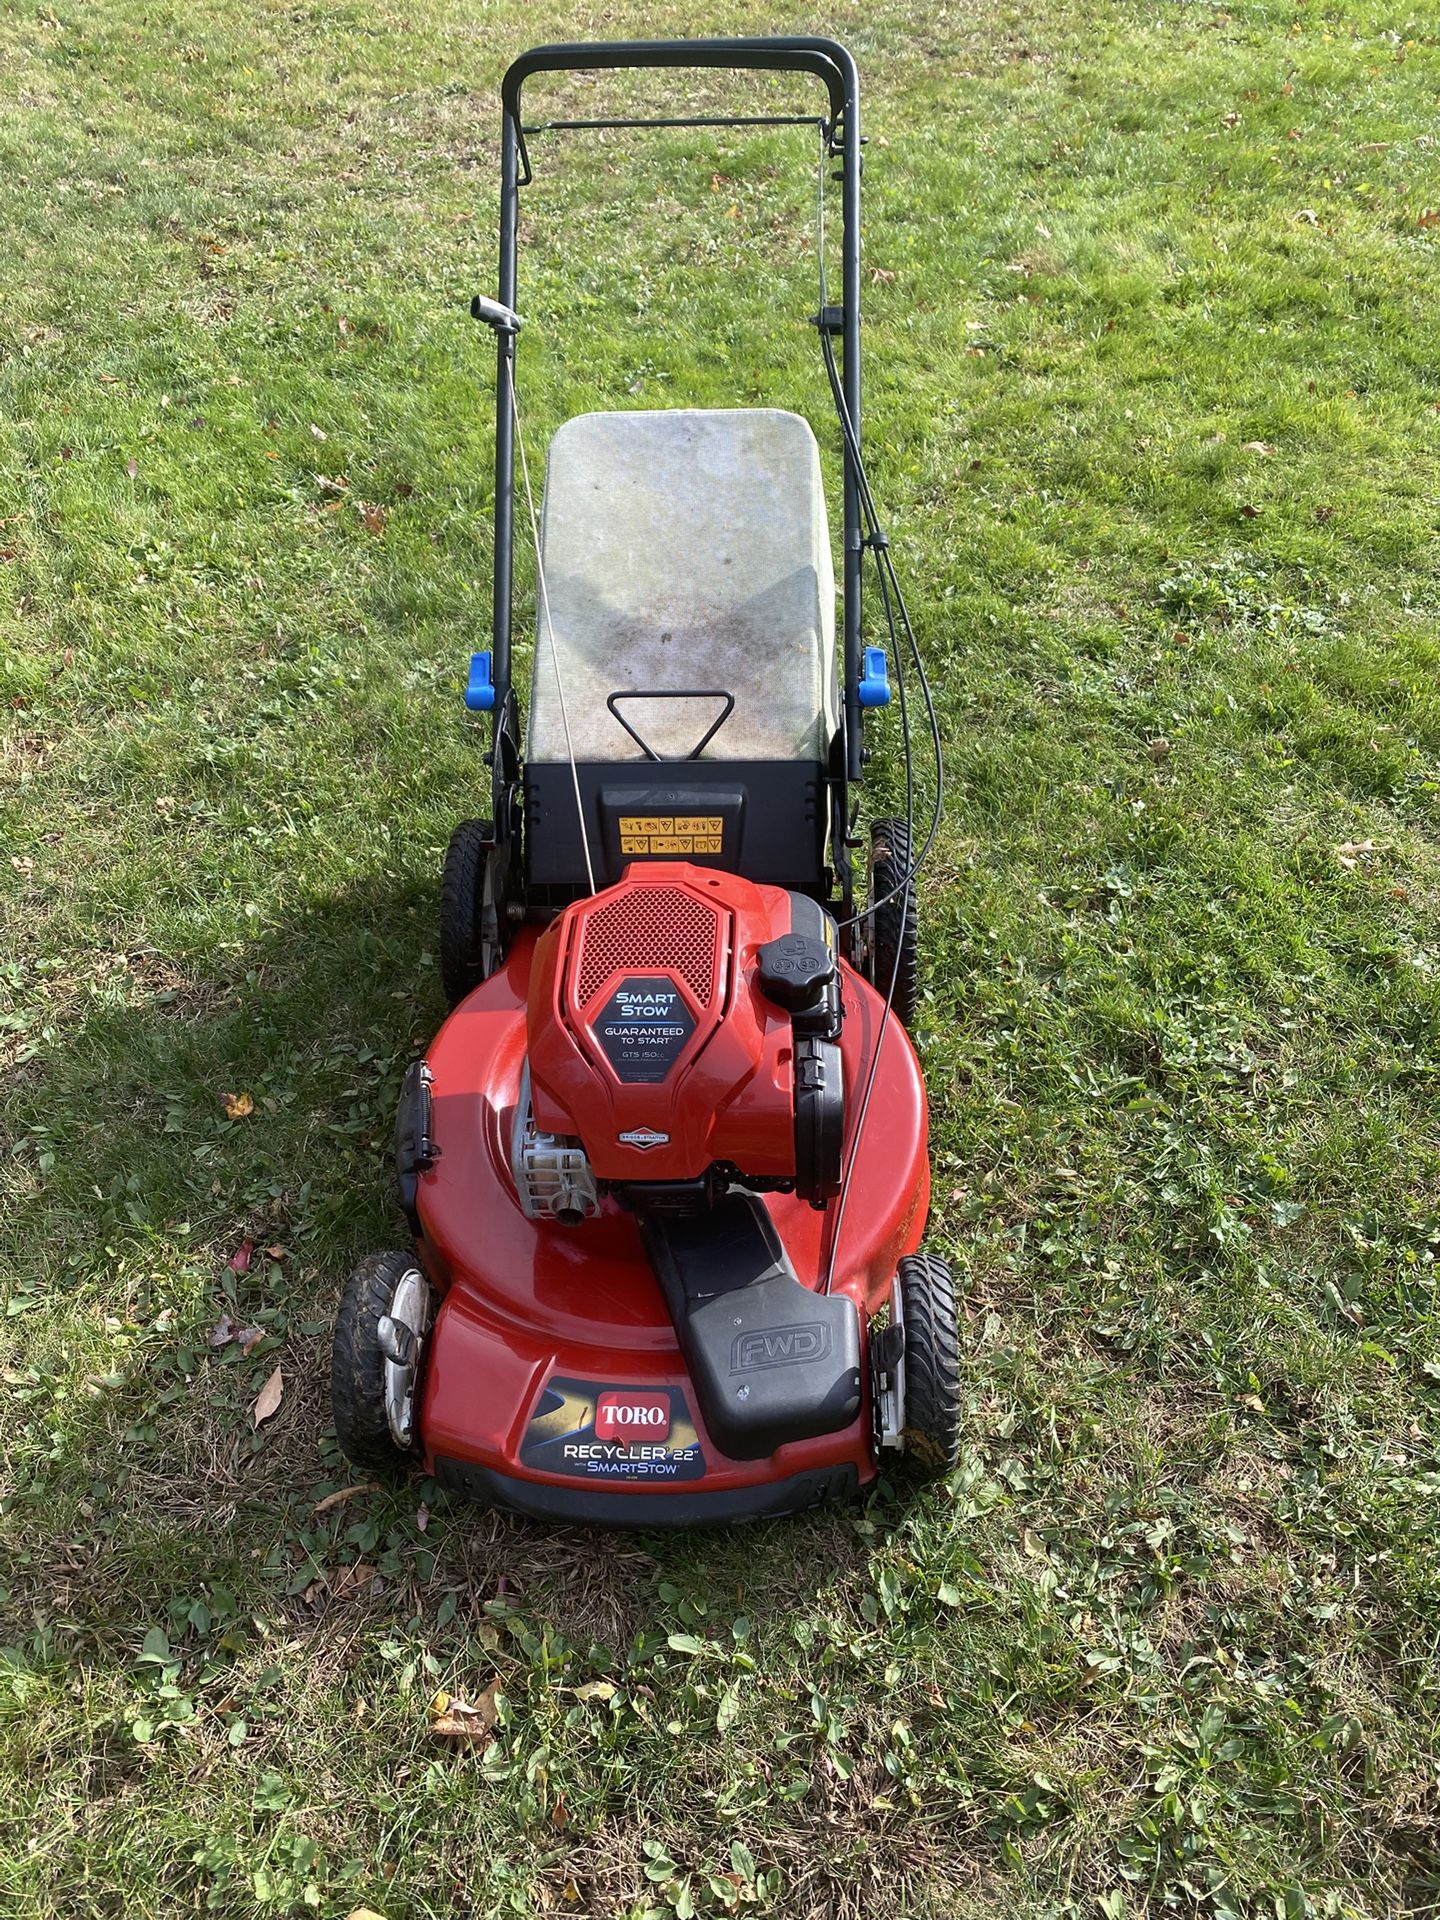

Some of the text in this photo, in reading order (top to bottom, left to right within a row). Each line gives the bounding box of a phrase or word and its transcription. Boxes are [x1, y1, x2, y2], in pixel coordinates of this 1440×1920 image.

[616, 992, 676, 1004] SMART
[621, 1005, 669, 1016] STOW
[604, 1027, 684, 1036] GUARANTEED
[637, 1037, 670, 1045] START
[746, 1330, 817, 1361] FWD
[601, 1405, 665, 1425] TORO
[563, 1444, 667, 1461] RECYCLER
